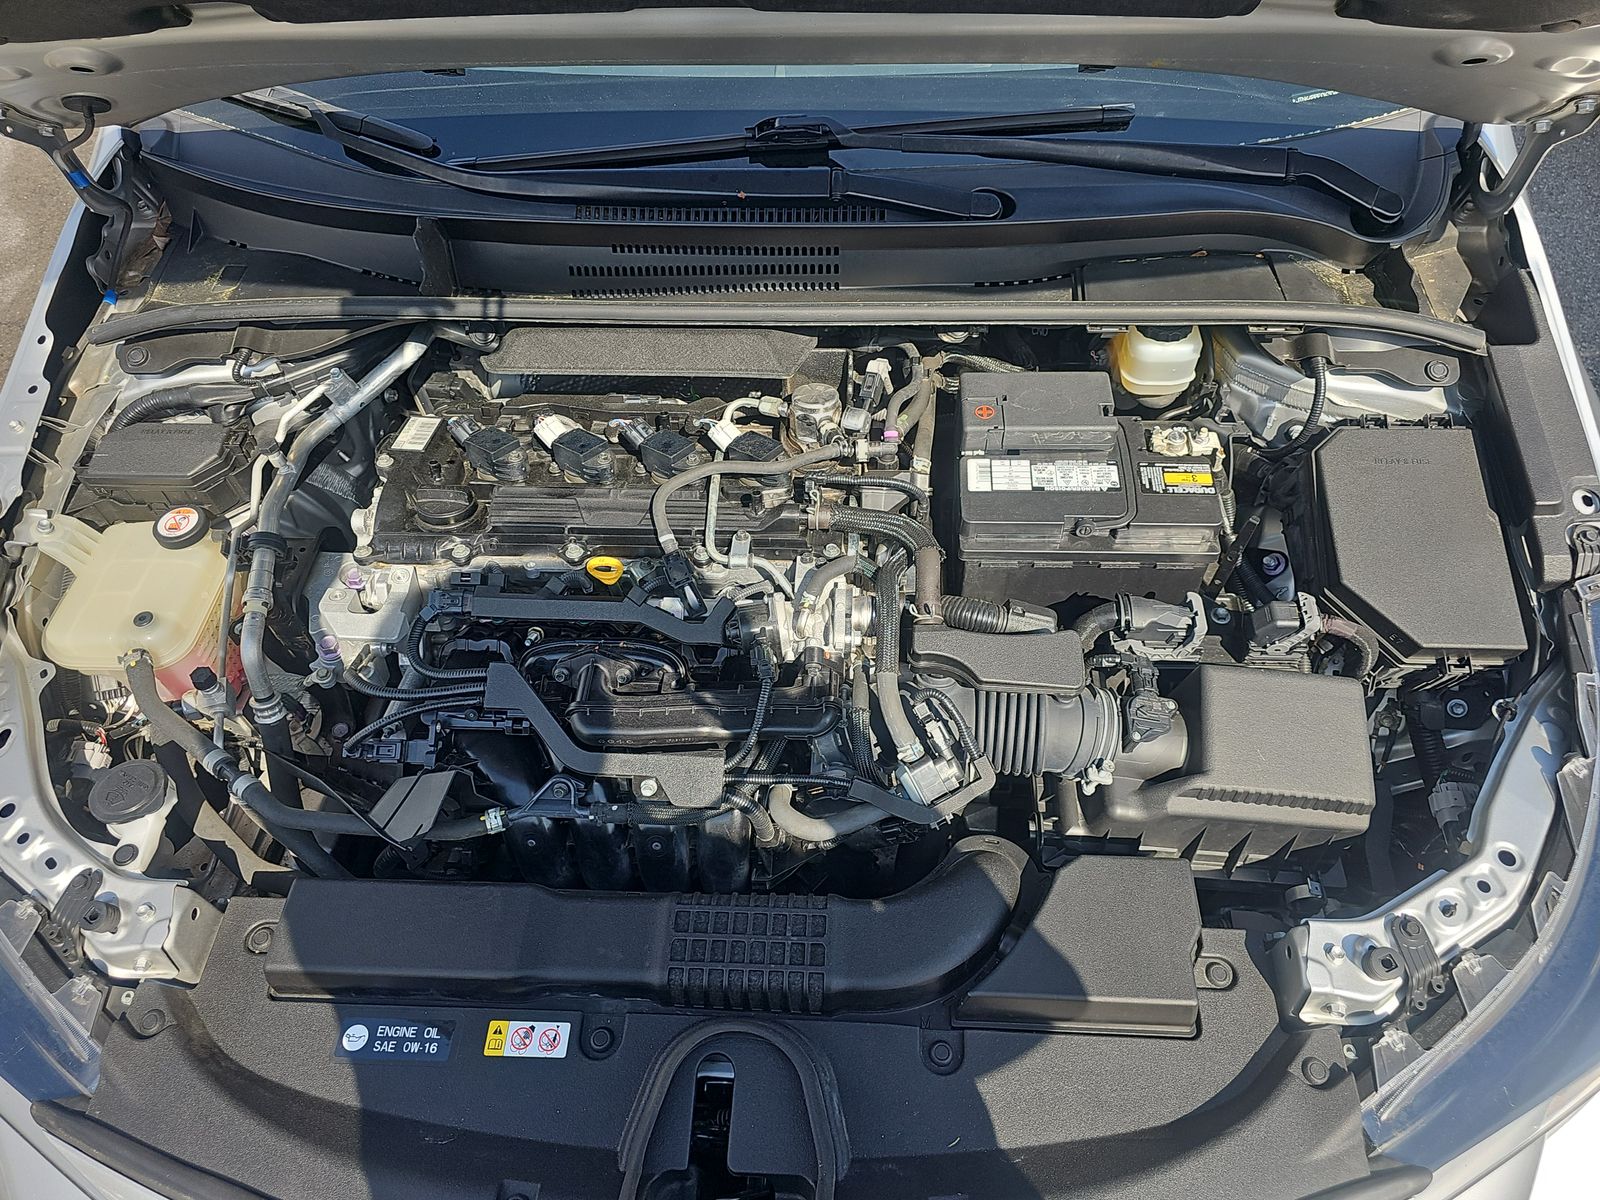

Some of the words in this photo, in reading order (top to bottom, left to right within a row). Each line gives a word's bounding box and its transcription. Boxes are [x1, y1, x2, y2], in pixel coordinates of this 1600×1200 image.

[1191, 474, 1198, 483] 3
[1166, 486, 1216, 494] DURACELL
[376, 1025, 418, 1038] ENGINE
[423, 1027, 441, 1039] OIL
[373, 1040, 397, 1053] SAE
[403, 1041, 439, 1054] 0W-16
